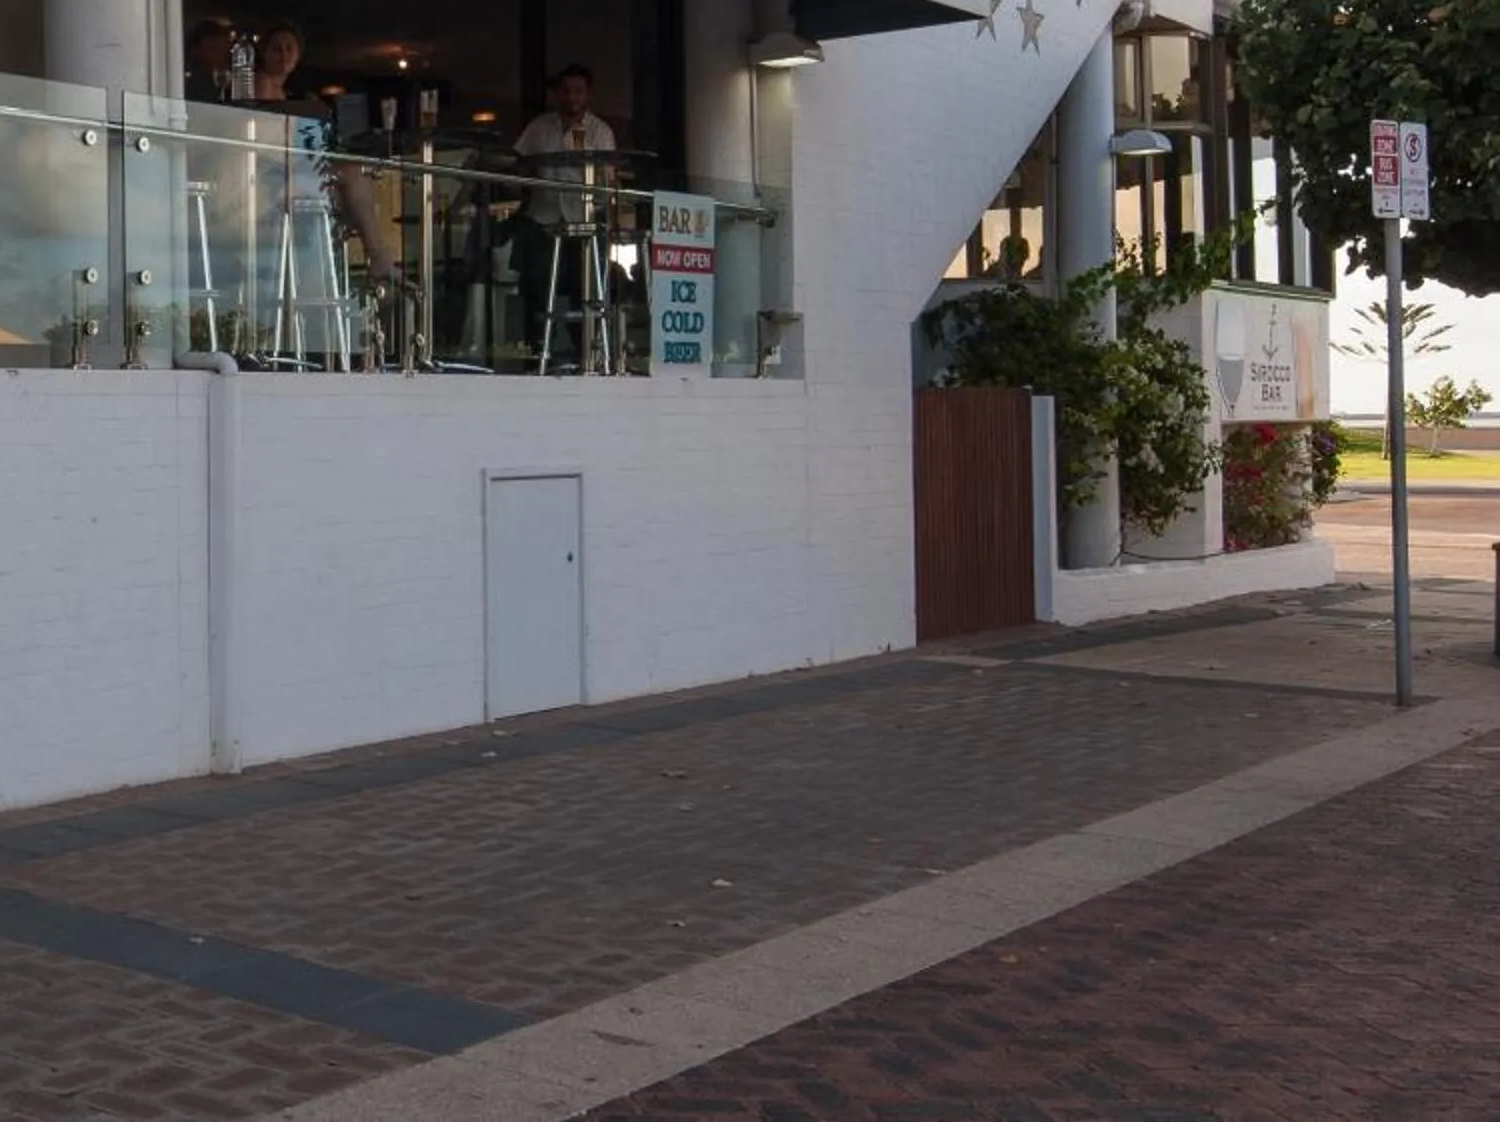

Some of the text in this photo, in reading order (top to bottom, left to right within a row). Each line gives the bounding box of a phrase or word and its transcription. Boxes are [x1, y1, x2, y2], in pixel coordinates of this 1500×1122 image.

[658, 205, 692, 234] BAR
[657, 248, 711, 270] NOW OPEN
[670, 279, 697, 303] ICE
[661, 310, 704, 334] COLD
[663, 341, 701, 364] BEER
